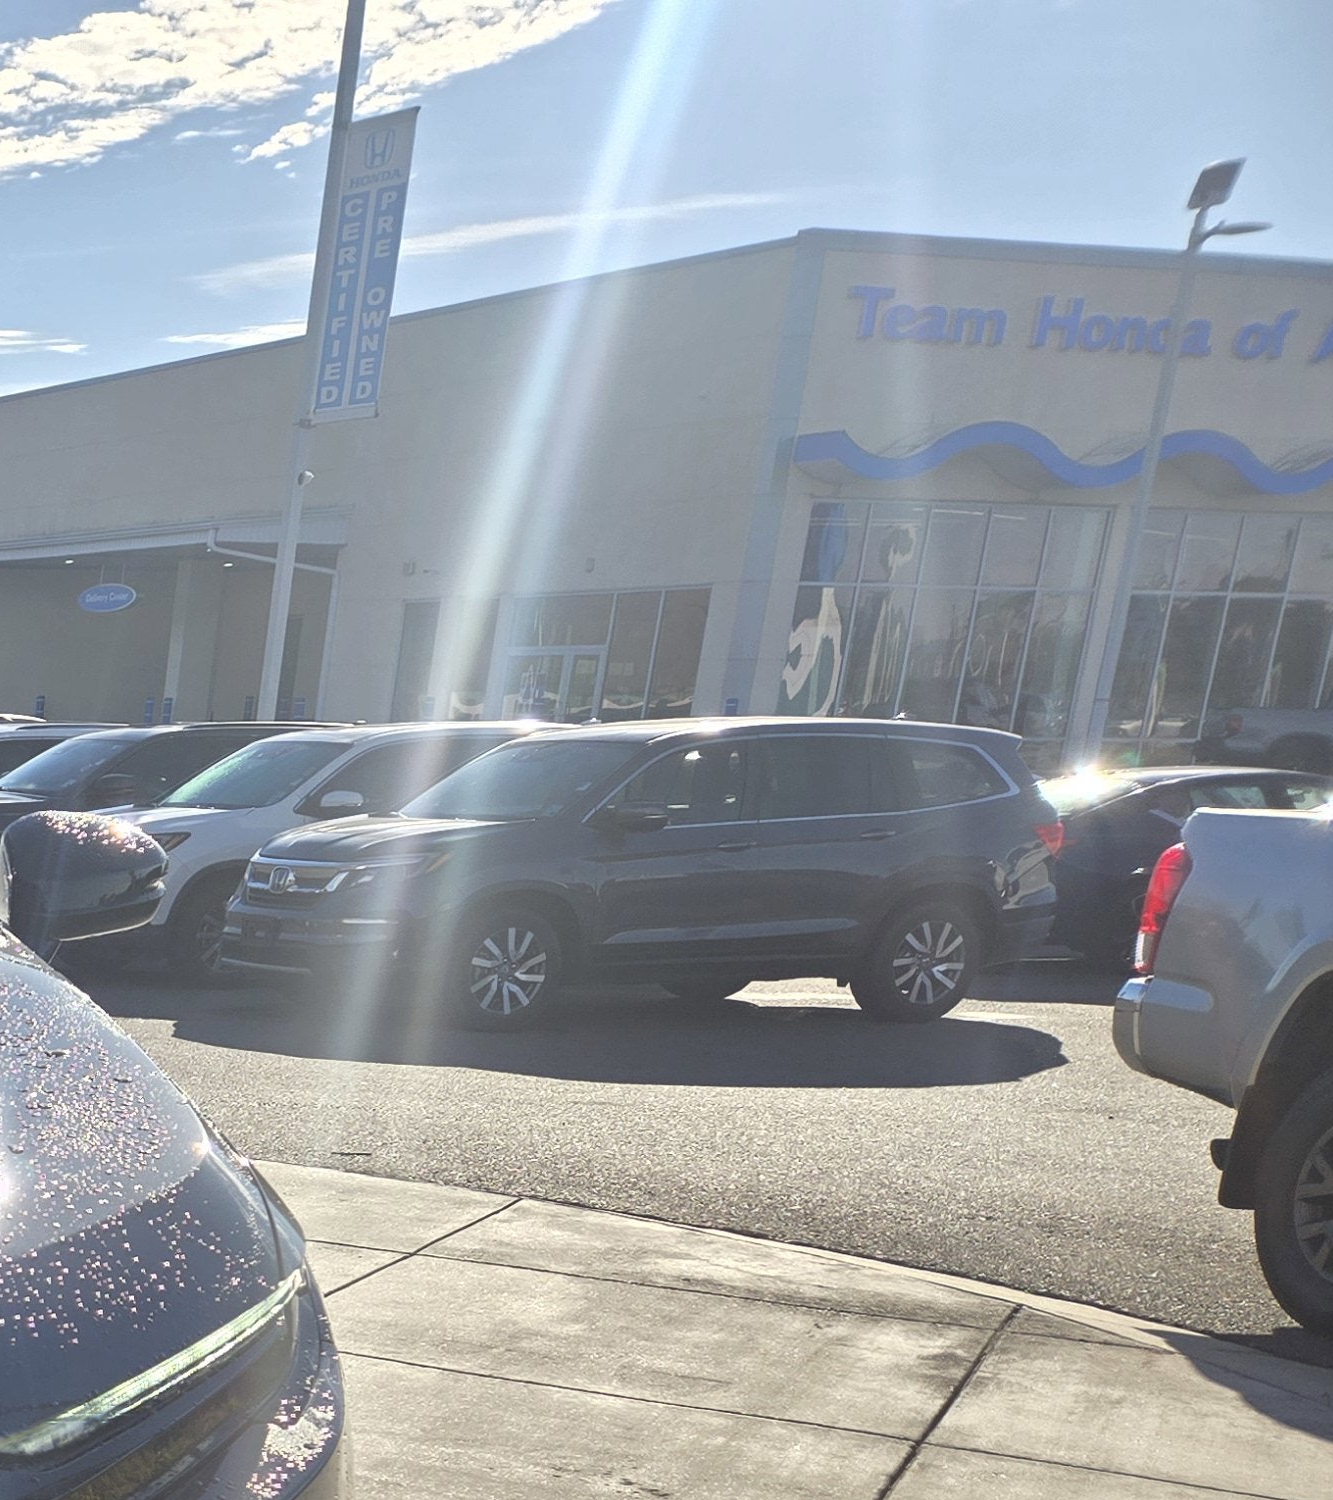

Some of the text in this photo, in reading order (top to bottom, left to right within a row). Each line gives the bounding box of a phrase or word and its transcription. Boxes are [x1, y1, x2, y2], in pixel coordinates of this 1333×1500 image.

[349, 168, 402, 188] HONDA
[320, 198, 363, 404] CERTIFIED
[356, 191, 397, 400] PRE OWNED
[850, 285, 1007, 344] Team
[1234, 308, 1300, 359] of
